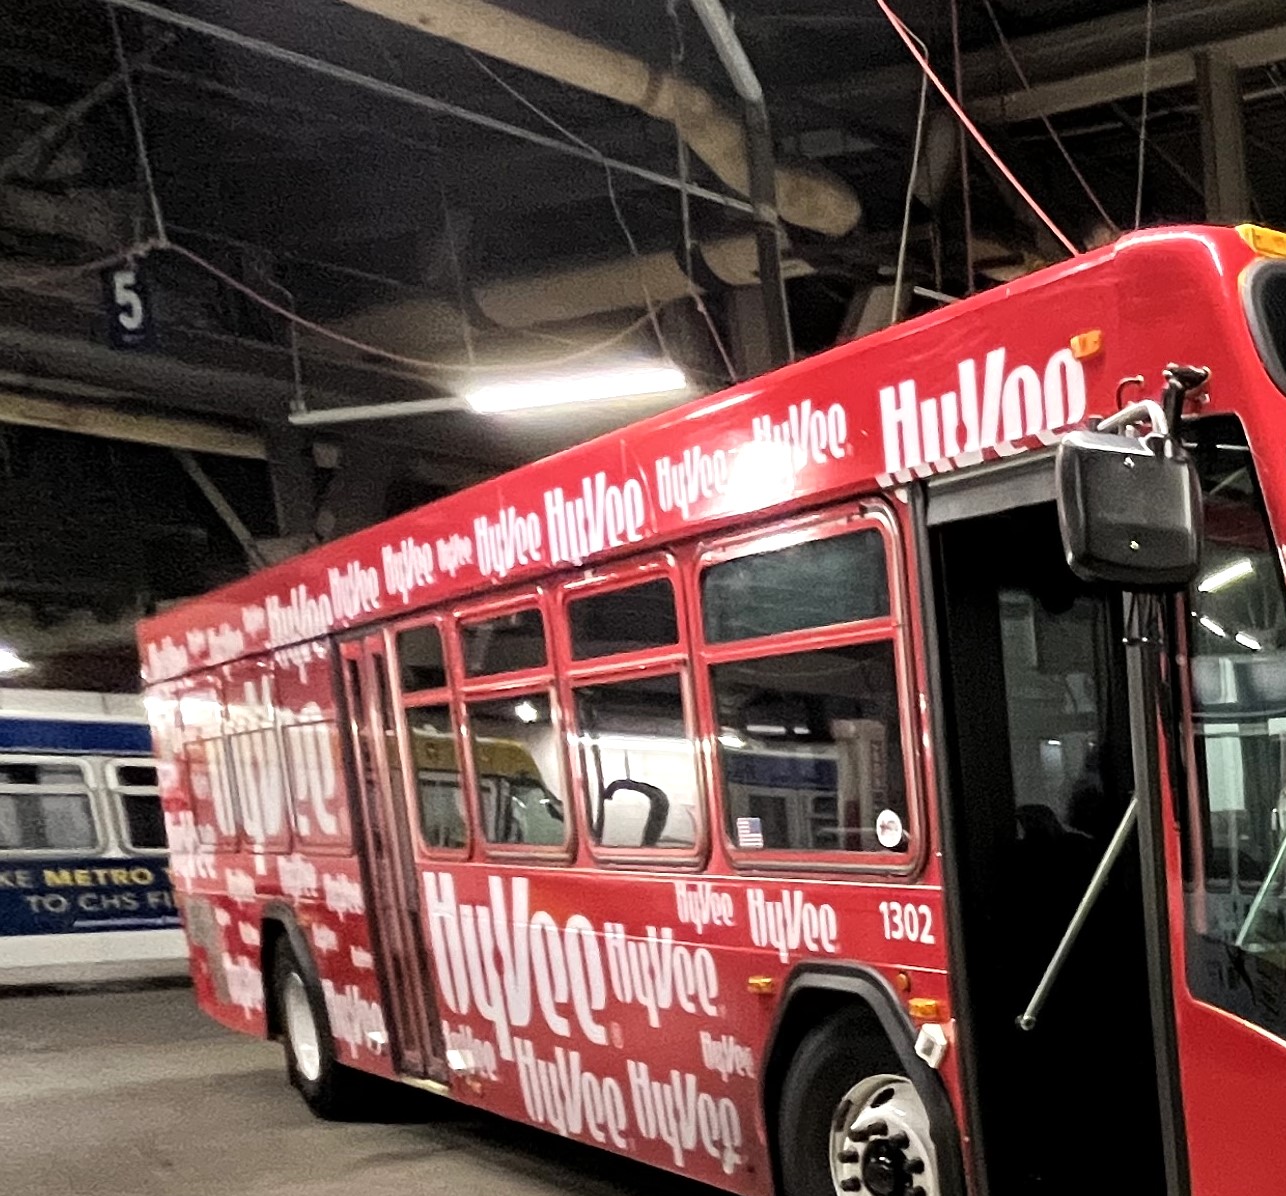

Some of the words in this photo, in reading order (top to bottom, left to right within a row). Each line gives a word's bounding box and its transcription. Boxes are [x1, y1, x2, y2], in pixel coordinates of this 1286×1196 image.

[114, 271, 142, 330] 5
[42, 868, 153, 887] METRO
[25, 894, 69, 913] TO
[77, 892, 140, 911] CHS
[879, 901, 935, 944] 1302
